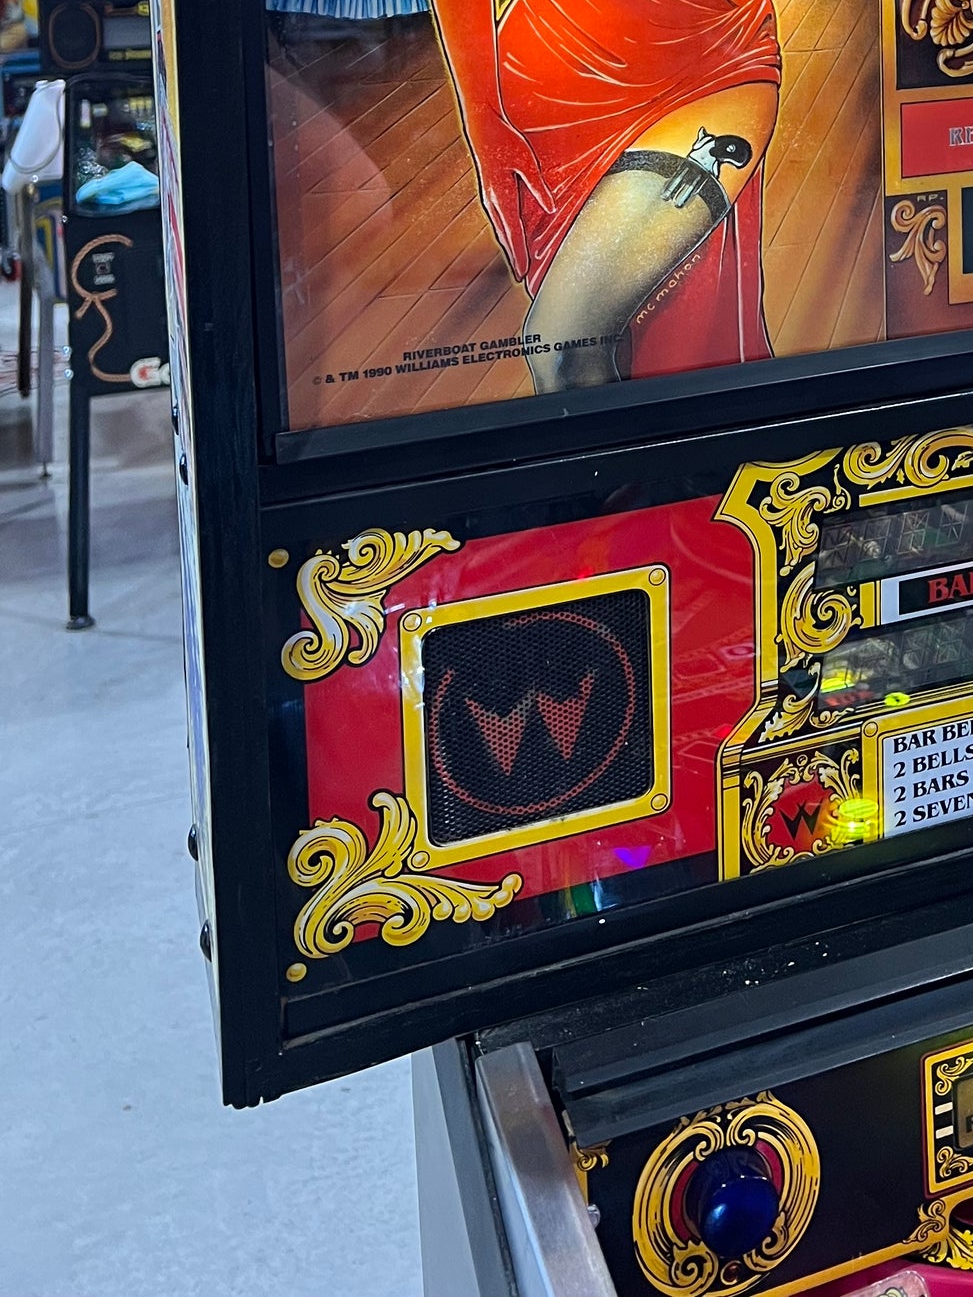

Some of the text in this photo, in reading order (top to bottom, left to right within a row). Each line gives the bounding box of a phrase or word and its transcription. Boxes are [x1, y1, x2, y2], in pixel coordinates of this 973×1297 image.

[325, 374, 335, 384] &
[339, 370, 359, 382] TM
[362, 366, 392, 378] 1990
[395, 356, 459, 374] WILLIAMS
[462, 344, 551, 364] ELECTRONICS
[553, 337, 597, 351] GAMES
[403, 334, 541, 362] RIVERBOAT GAMBLER
[893, 729, 937, 754] BAR
[893, 762, 905, 779] 2
[894, 786, 906, 803] 2
[913, 769, 969, 798] BARS
[894, 810, 906, 828] 2
